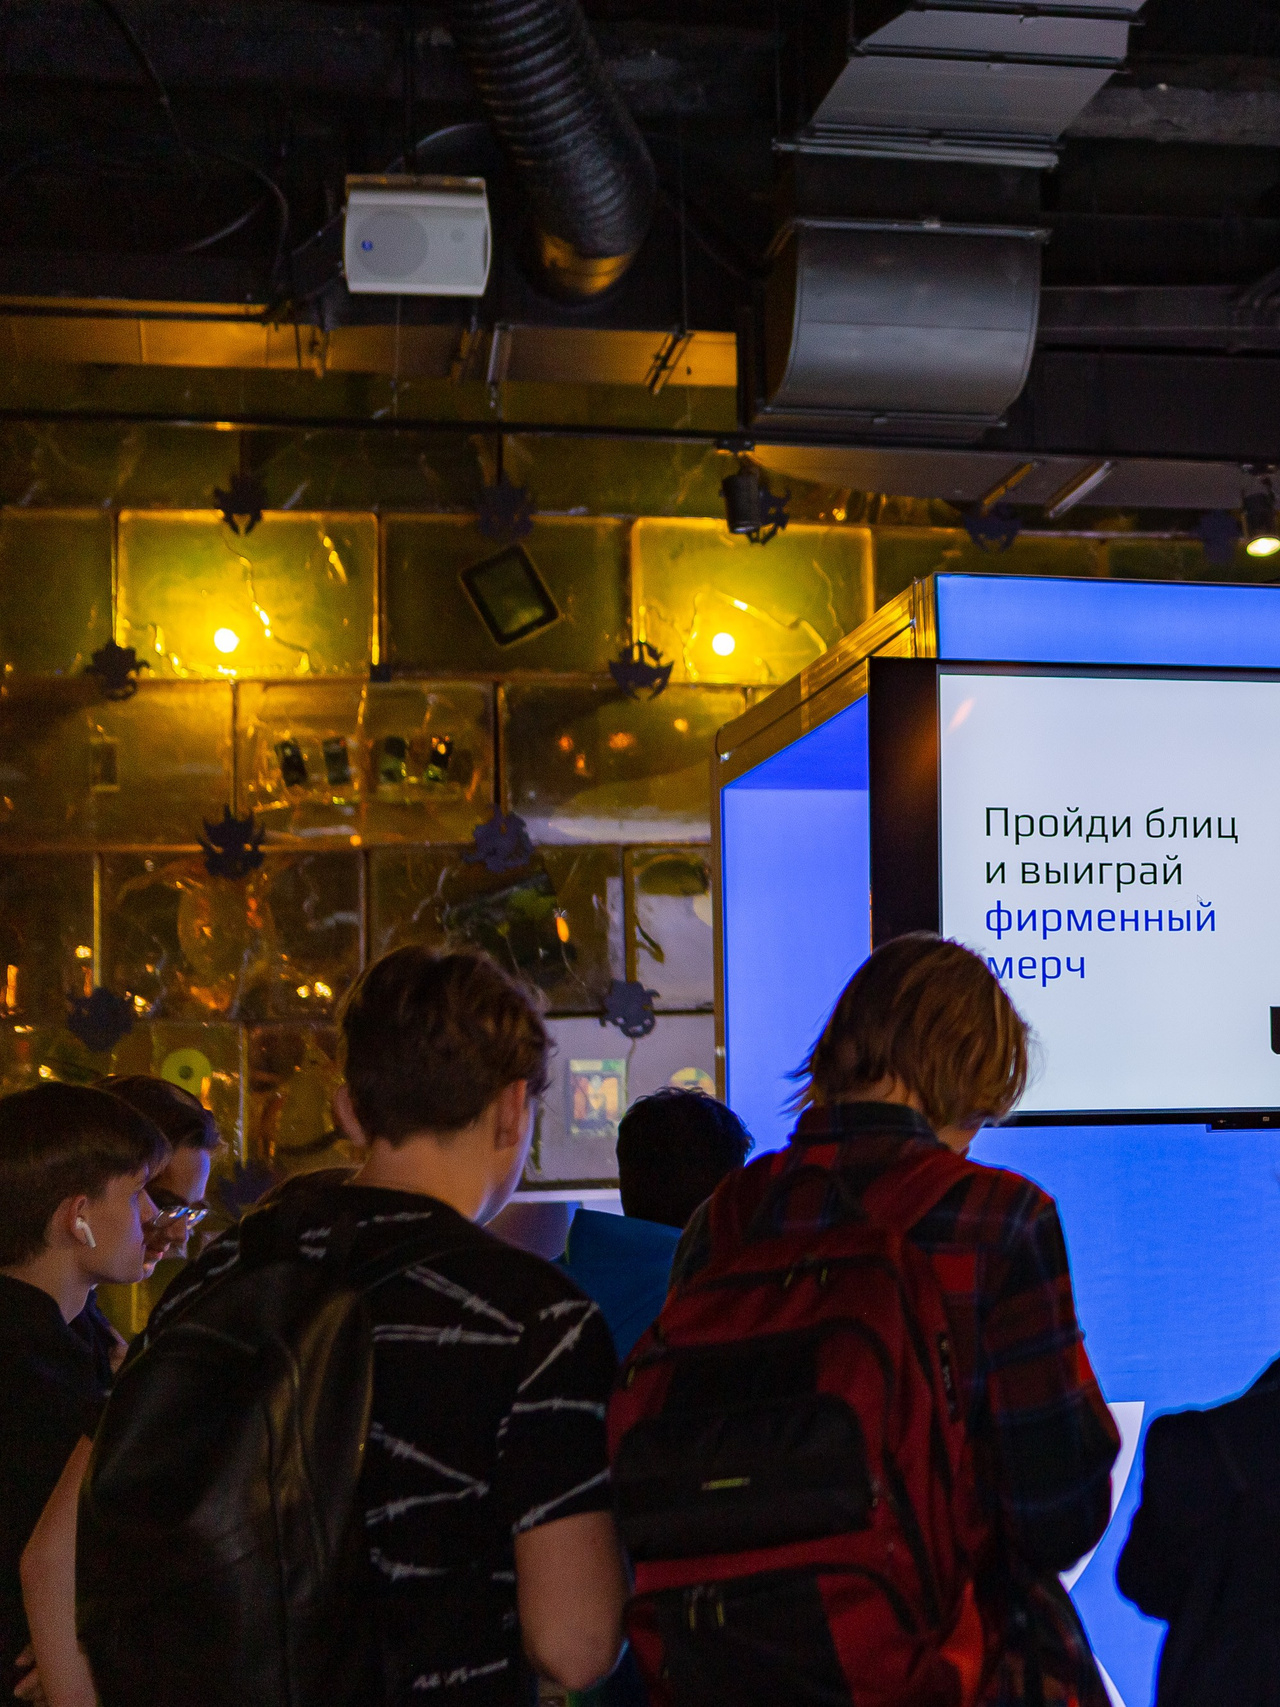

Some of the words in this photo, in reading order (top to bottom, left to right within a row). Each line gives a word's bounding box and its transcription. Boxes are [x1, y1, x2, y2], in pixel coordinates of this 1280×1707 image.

[985, 806, 1132, 845] Пройди
[1146, 806, 1239, 844] блиц
[985, 861, 1006, 884] и
[1021, 854, 1182, 893] выиграй
[985, 900, 1216, 940] фирменный
[987, 956, 1086, 988] мерч
